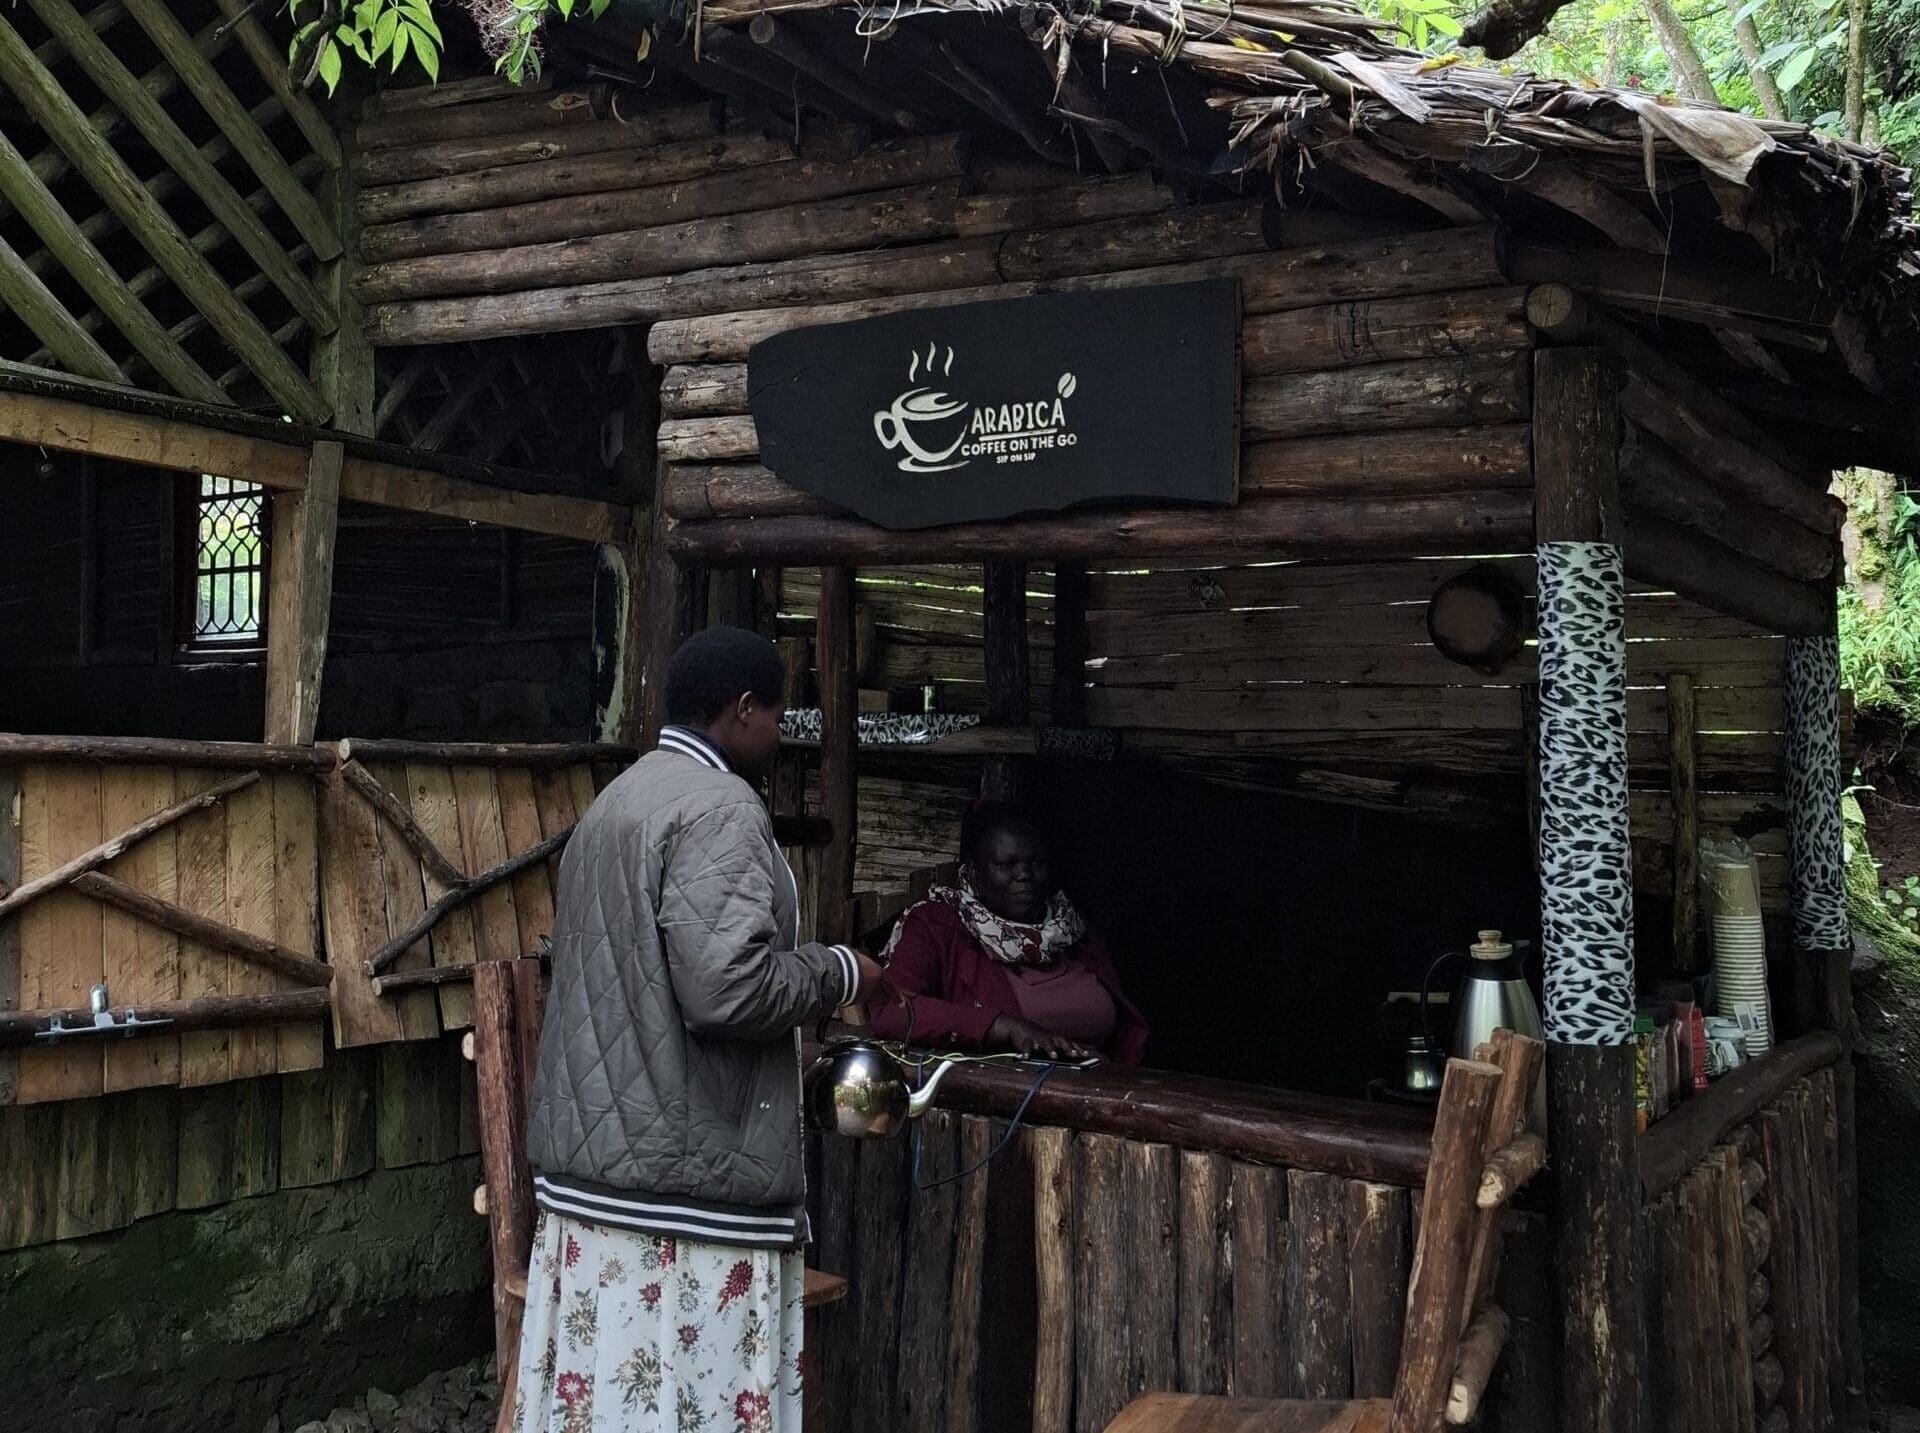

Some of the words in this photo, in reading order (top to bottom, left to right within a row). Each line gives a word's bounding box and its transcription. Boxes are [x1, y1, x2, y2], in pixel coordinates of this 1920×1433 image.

[971, 398, 1066, 435] ARABICA
[961, 440, 1007, 456] COFFEE
[1009, 439, 1029, 451] ON
[1030, 436, 1055, 450] THE
[1057, 433, 1078, 447] GO
[996, 455, 1009, 464] SIP
[1010, 454, 1022, 463] ON
[1023, 452, 1036, 462] SIP
